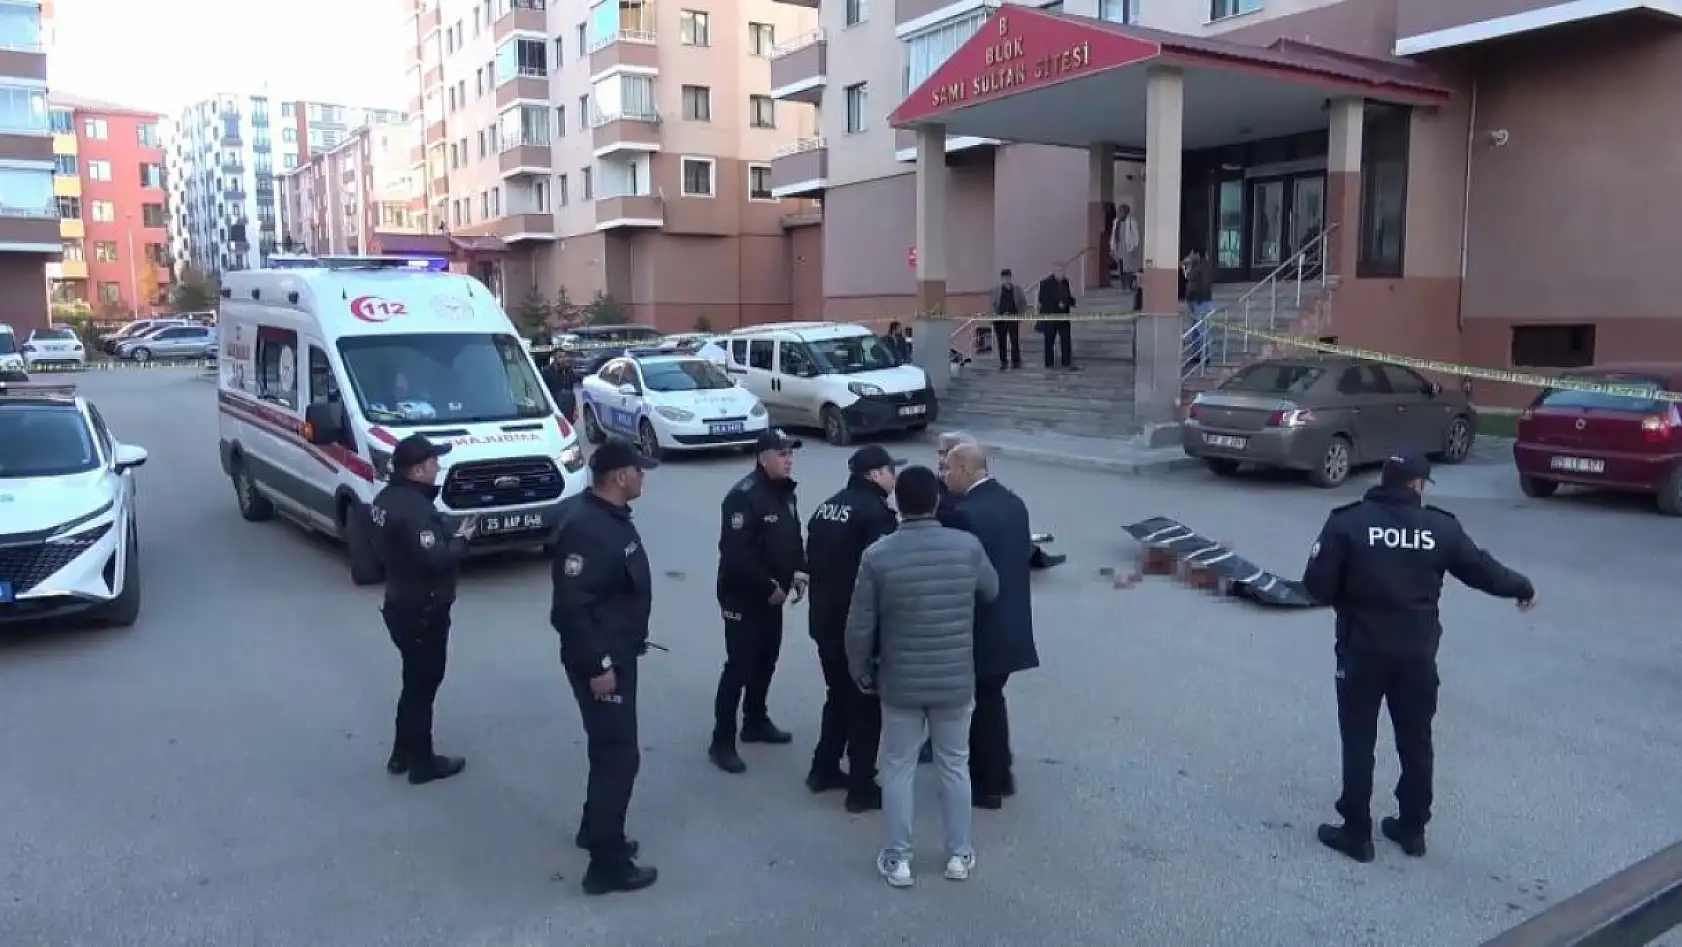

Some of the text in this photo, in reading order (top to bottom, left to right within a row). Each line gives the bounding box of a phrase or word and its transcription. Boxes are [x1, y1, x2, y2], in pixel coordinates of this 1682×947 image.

[999, 17, 1009, 36] B
[985, 36, 1024, 65] BLOK
[973, 64, 1026, 95] SULTAN
[362, 302, 408, 316] 112
